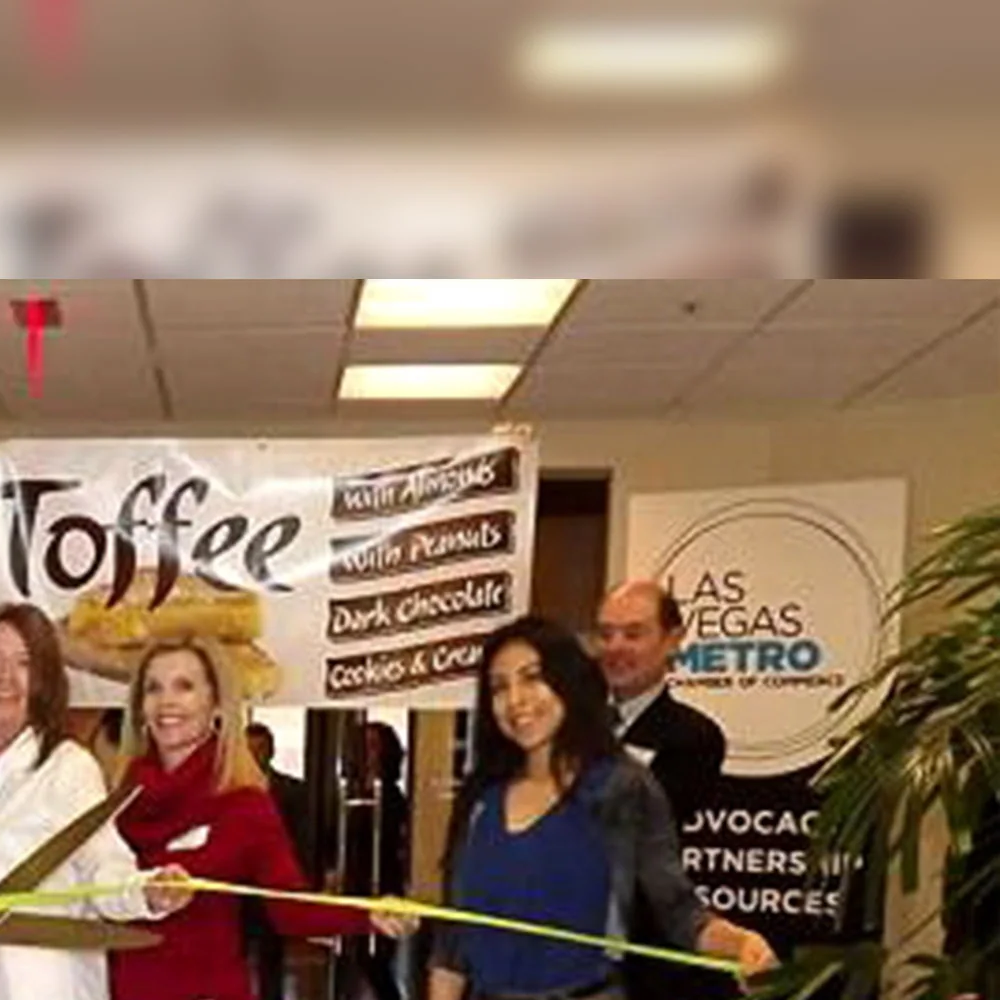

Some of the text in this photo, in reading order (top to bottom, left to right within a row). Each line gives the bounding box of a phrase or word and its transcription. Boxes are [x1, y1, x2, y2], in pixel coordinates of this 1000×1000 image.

[667, 571, 746, 604] LAS
[332, 580, 504, 634] Dark Chocolate
[329, 656, 405, 690] Cookies
[667, 640, 821, 674] METRO
[682, 809, 821, 838] DVOCAC
[693, 883, 842, 916] SOURCES
